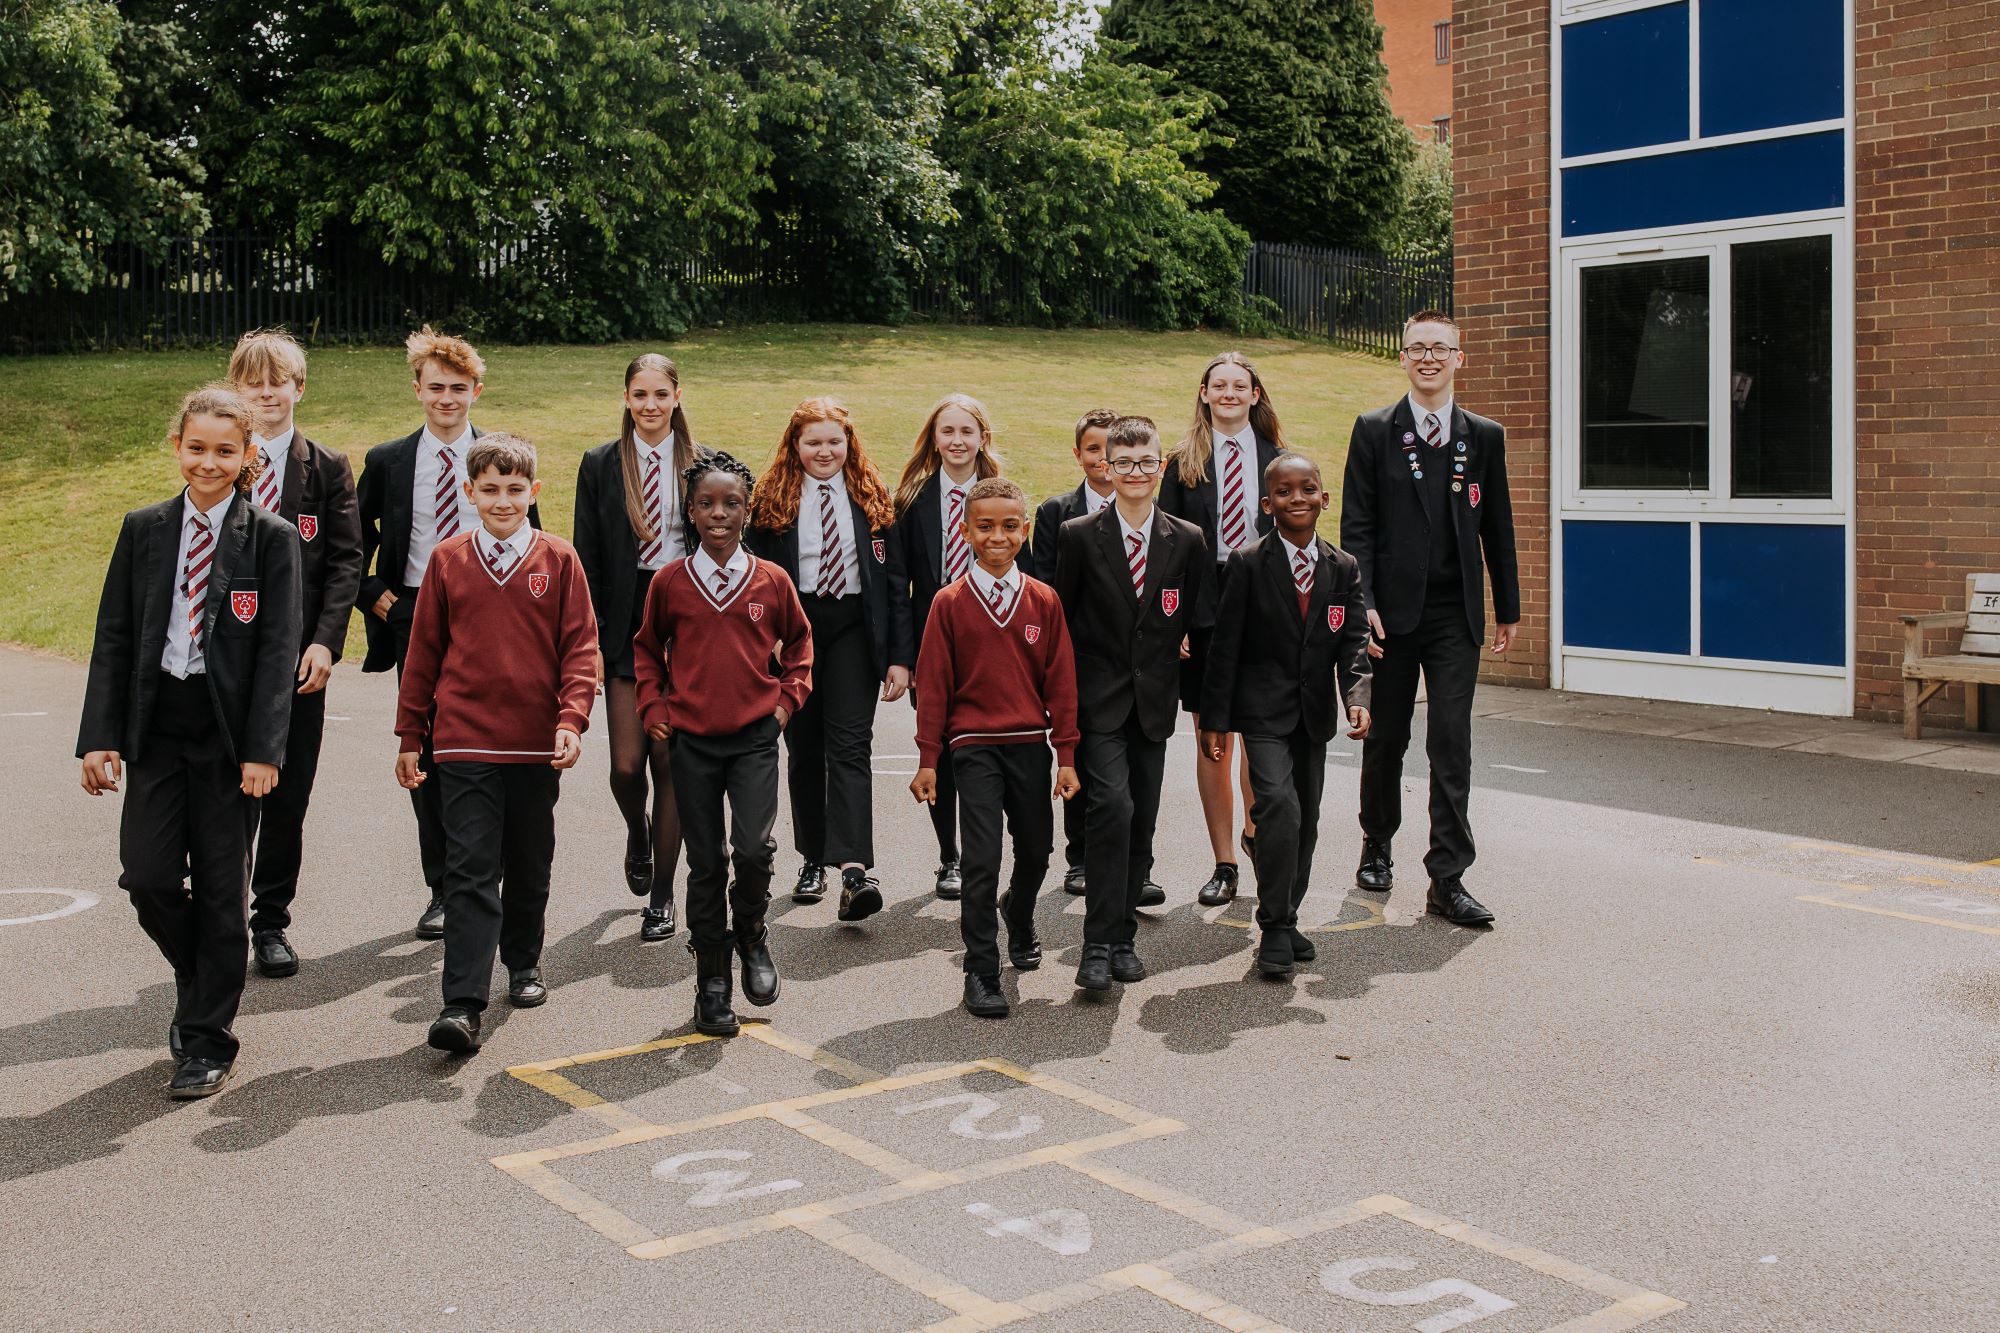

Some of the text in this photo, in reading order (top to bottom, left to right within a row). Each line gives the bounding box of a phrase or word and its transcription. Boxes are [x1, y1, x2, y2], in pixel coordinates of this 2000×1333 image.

[1983, 596, 1999, 608] If
[894, 1092, 1045, 1140] 2
[651, 1150, 804, 1208] 3
[963, 1203, 1092, 1256] 4
[1319, 1255, 1517, 1333] 5
